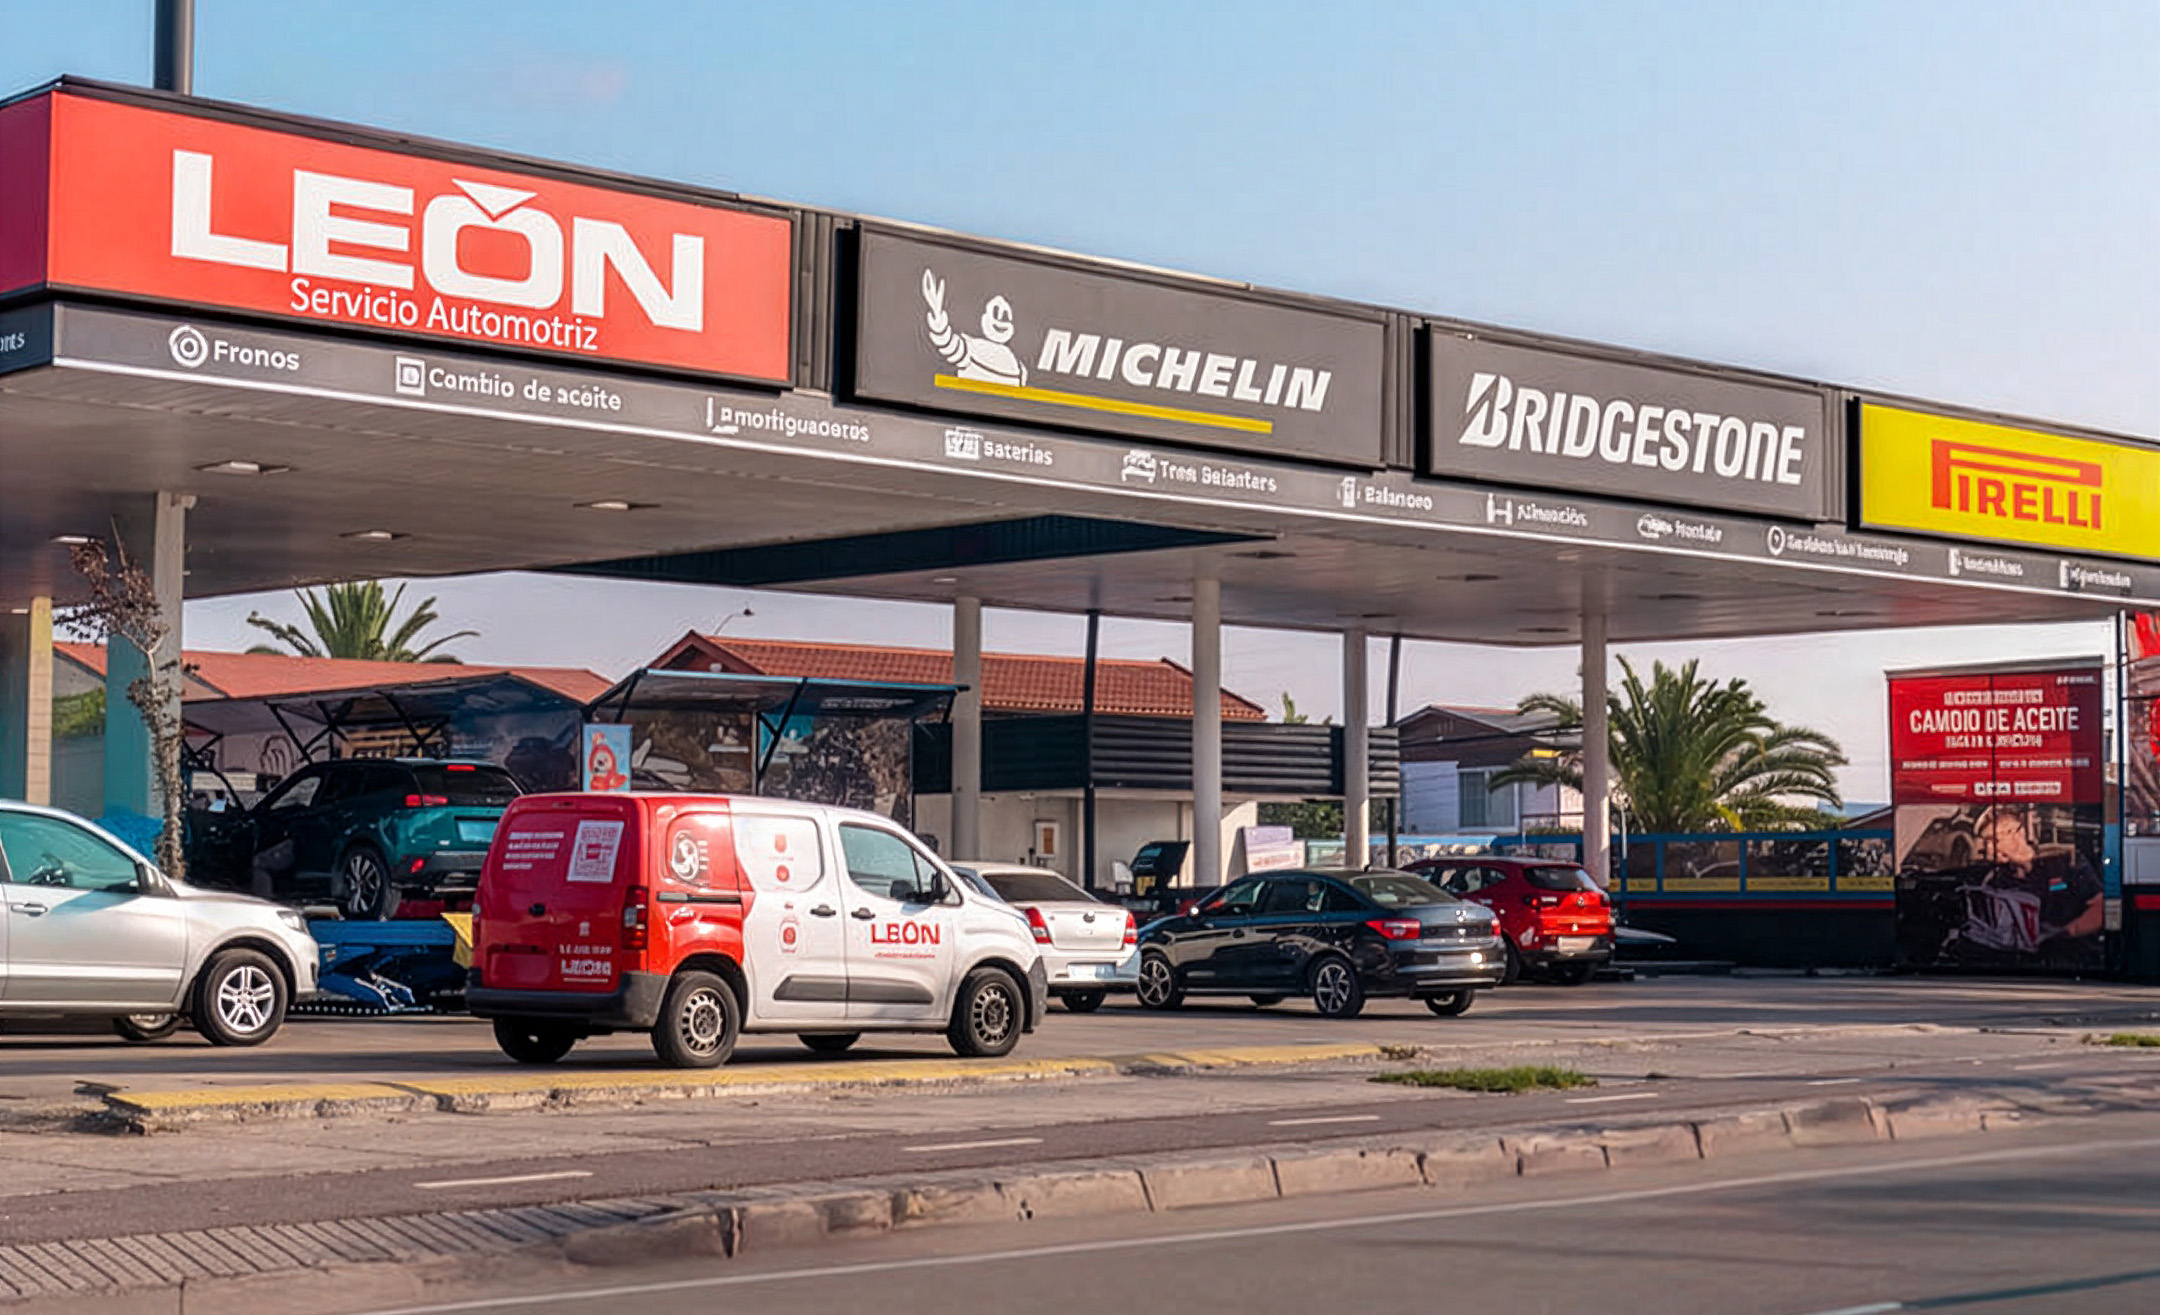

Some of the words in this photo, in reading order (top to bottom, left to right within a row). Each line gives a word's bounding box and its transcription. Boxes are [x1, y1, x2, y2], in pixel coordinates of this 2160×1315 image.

[290, 278, 419, 327] Servicio
[427, 296, 599, 351] Automotriz
[213, 340, 300, 371] Fronos
[523, 379, 551, 402] de
[1038, 328, 1333, 413] MICHELIN
[1459, 372, 1805, 486] BRIDGESTONE
[1931, 439, 2102, 531] PIRELLI
[1985, 708, 2010, 732] DE
[2013, 705, 2080, 731] ACEITE
